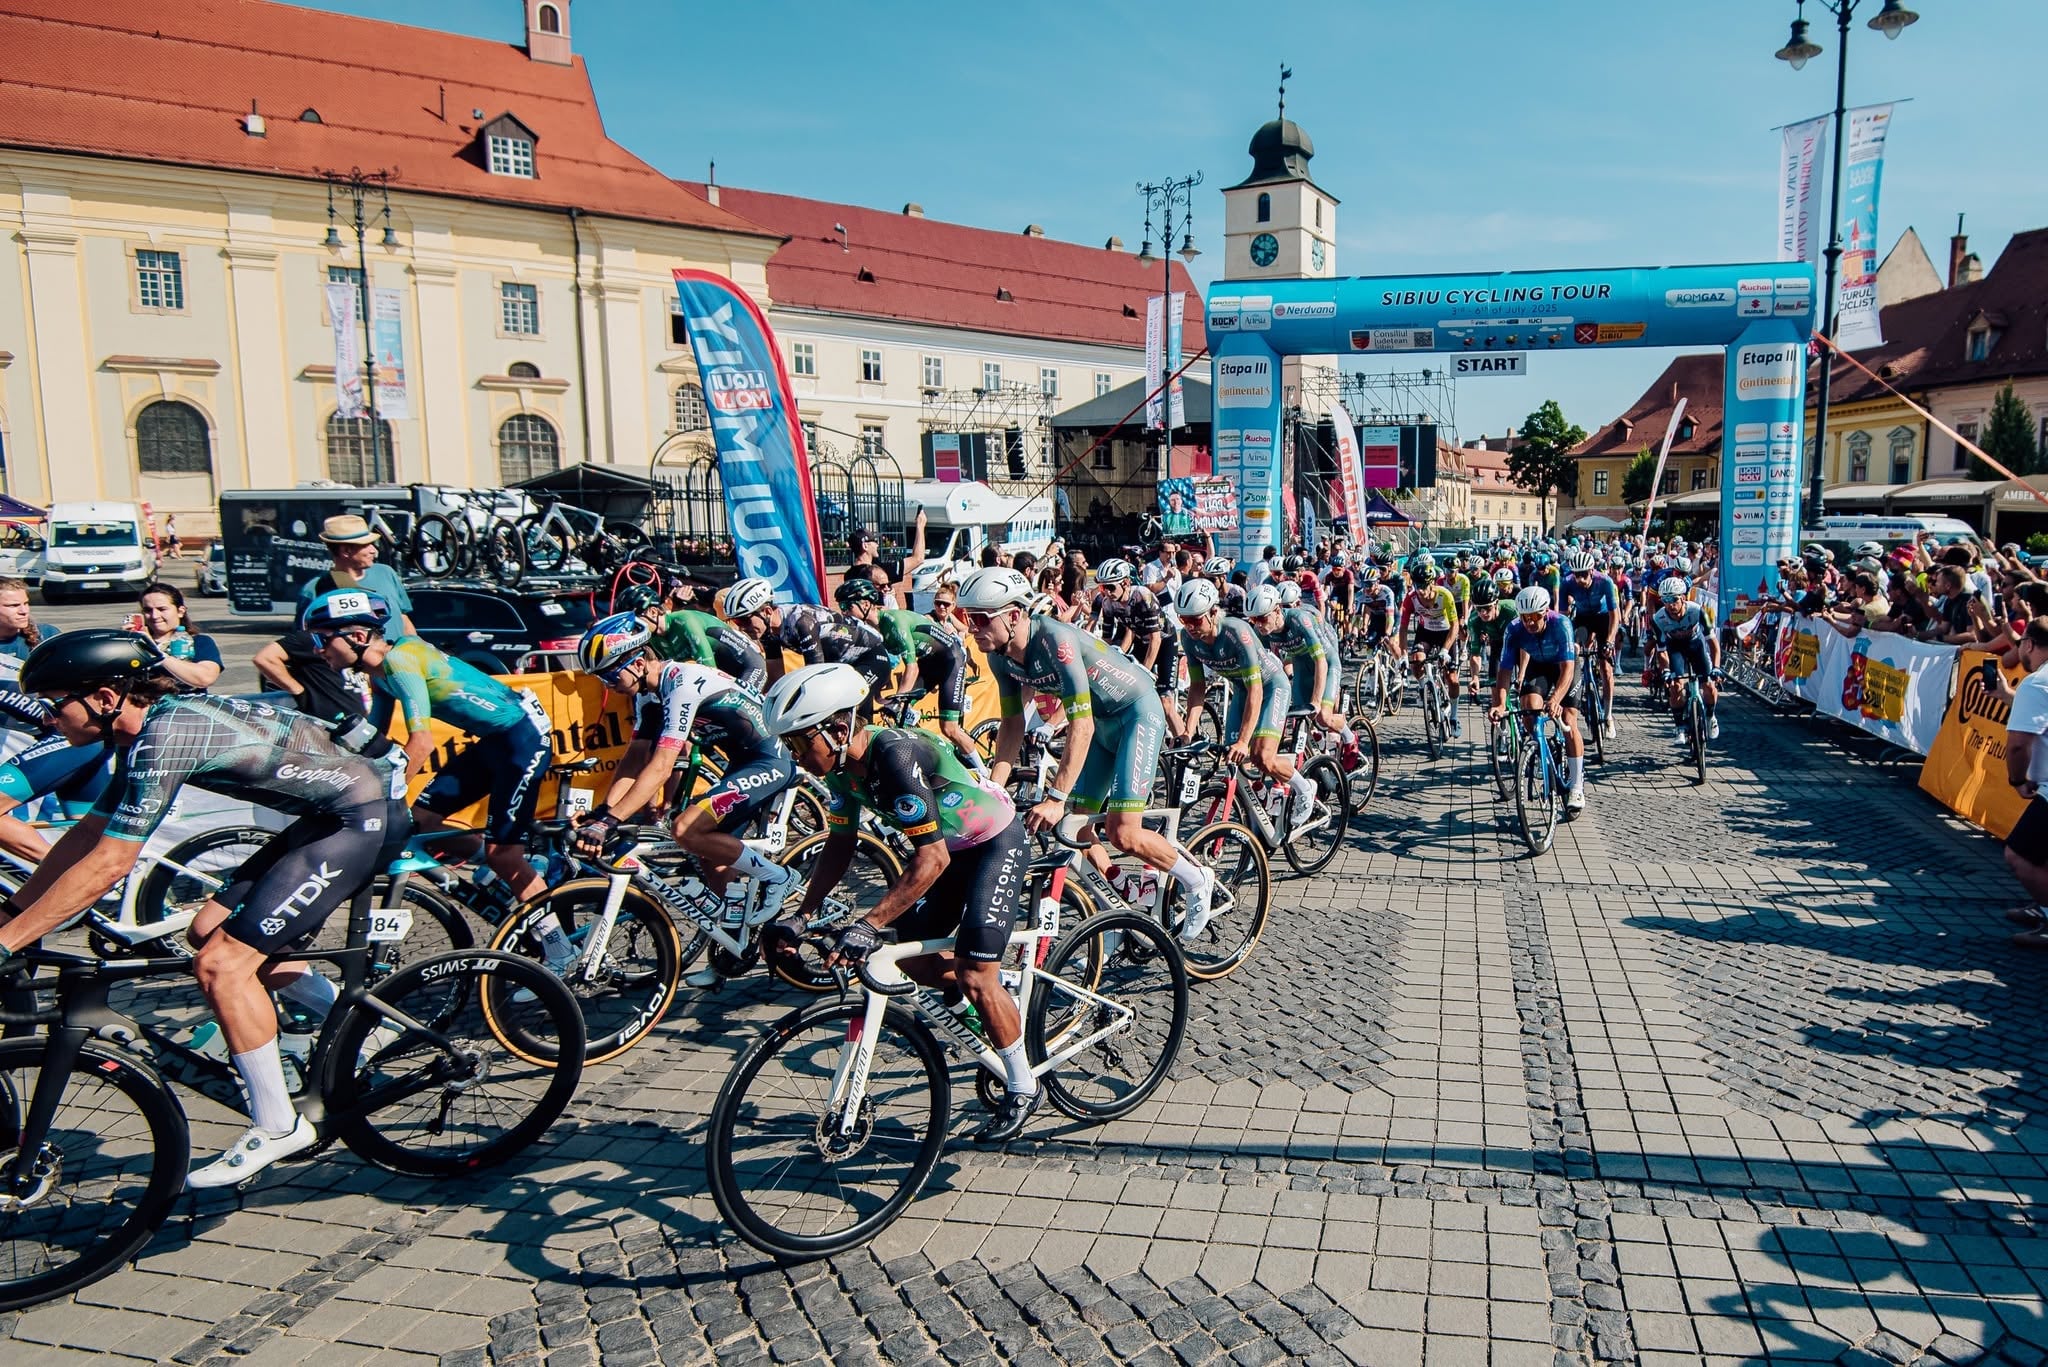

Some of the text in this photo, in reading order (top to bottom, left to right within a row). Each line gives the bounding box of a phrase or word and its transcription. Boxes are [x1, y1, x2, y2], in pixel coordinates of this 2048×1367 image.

[1381, 284, 1612, 306] SIBIU CYCLING TOUR
[1676, 292, 1725, 303] ROMGAZ
[1739, 283, 1772, 291] Auchan
[1842, 288, 1872, 301] TURUL
[1286, 306, 1335, 315] Nerdvana
[1491, 305, 1502, 314] of
[1505, 304, 1526, 316] July
[1532, 304, 1557, 313] 2025
[1840, 297, 1876, 311] CICLIST
[1211, 317, 1235, 326] ROCK
[1373, 330, 1408, 338] Consiliul
[1599, 332, 1623, 340] SIBIU
[1457, 357, 1519, 371] START
[1743, 349, 1797, 365] Etapa III
[1221, 363, 1268, 376] Etapa III
[1739, 376, 1794, 391] Continental
[2003, 490, 2035, 500] AMBER
[338, 597, 360, 610] 56
[747, 592, 763, 607] 104
[1095, 659, 1137, 686] BENOTTI
[1098, 676, 1127, 702] Berthold
[0, 689, 46, 720] AHRAIN
[718, 691, 767, 732] hansgro
[678, 702, 691, 733] BORA
[1967, 728, 1984, 750] The
[1131, 723, 1147, 795] BENOTTI
[1144, 728, 1157, 775] Berthold
[507, 750, 546, 822] ASTANA
[736, 768, 785, 791] BORA
[1185, 779, 1196, 800] 156
[1244, 785, 1269, 826] BENOTTI
[771, 830, 781, 846] 33
[272, 861, 344, 918] TDK
[985, 848, 1017, 924] VICTORIA
[998, 849, 1023, 927] SPORTS
[1087, 871, 1126, 910] BENOT
[646, 872, 715, 933] S-WORKS
[374, 917, 400, 932] 84
[502, 900, 552, 954] oval
[1044, 910, 1055, 931] 94
[421, 957, 500, 981] DT SWISS
[617, 982, 668, 1047] roval
[916, 989, 988, 1055] SPECIALIZED
[847, 1047, 868, 1116] SPECIALIZED
